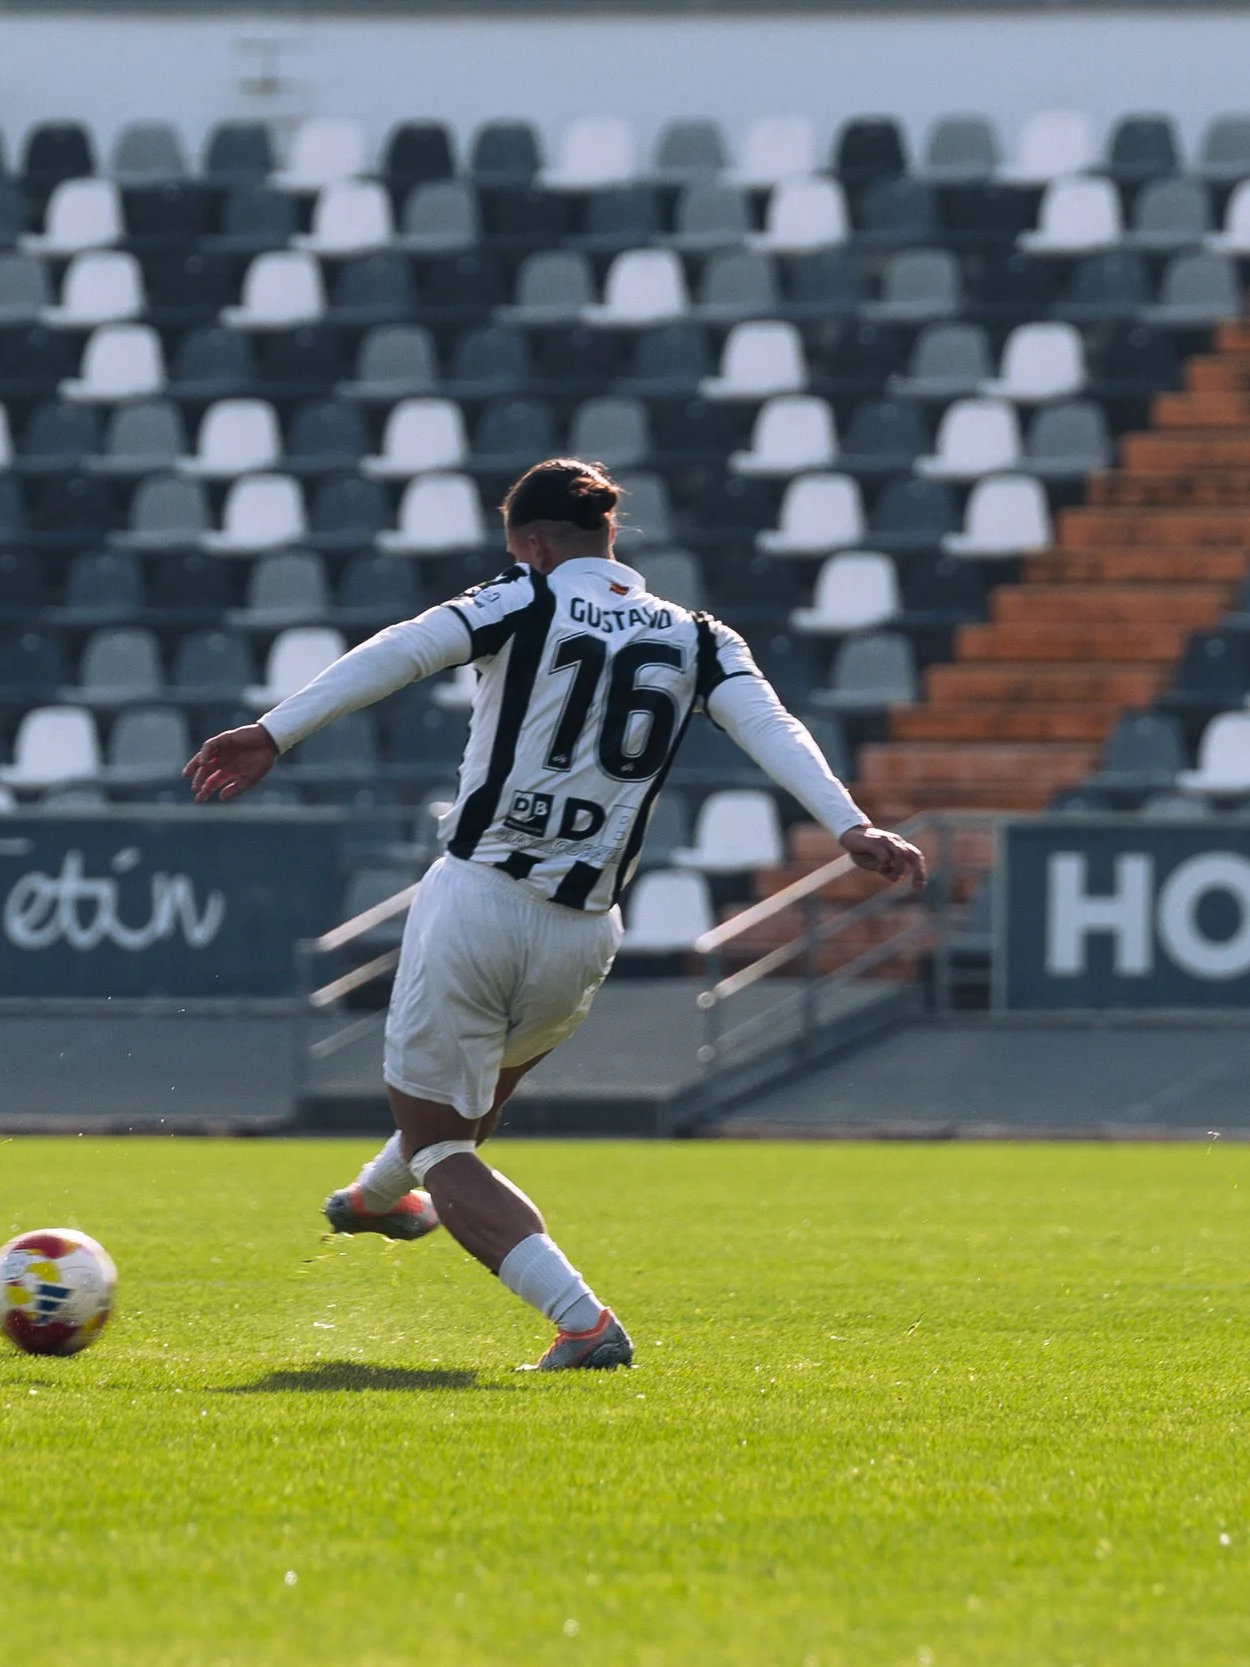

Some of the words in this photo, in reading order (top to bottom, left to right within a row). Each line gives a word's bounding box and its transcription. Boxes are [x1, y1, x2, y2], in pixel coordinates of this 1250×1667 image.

[570, 597, 673, 633] GUSTAVO
[543, 631, 686, 783] 16
[1045, 848, 1250, 981] HO
